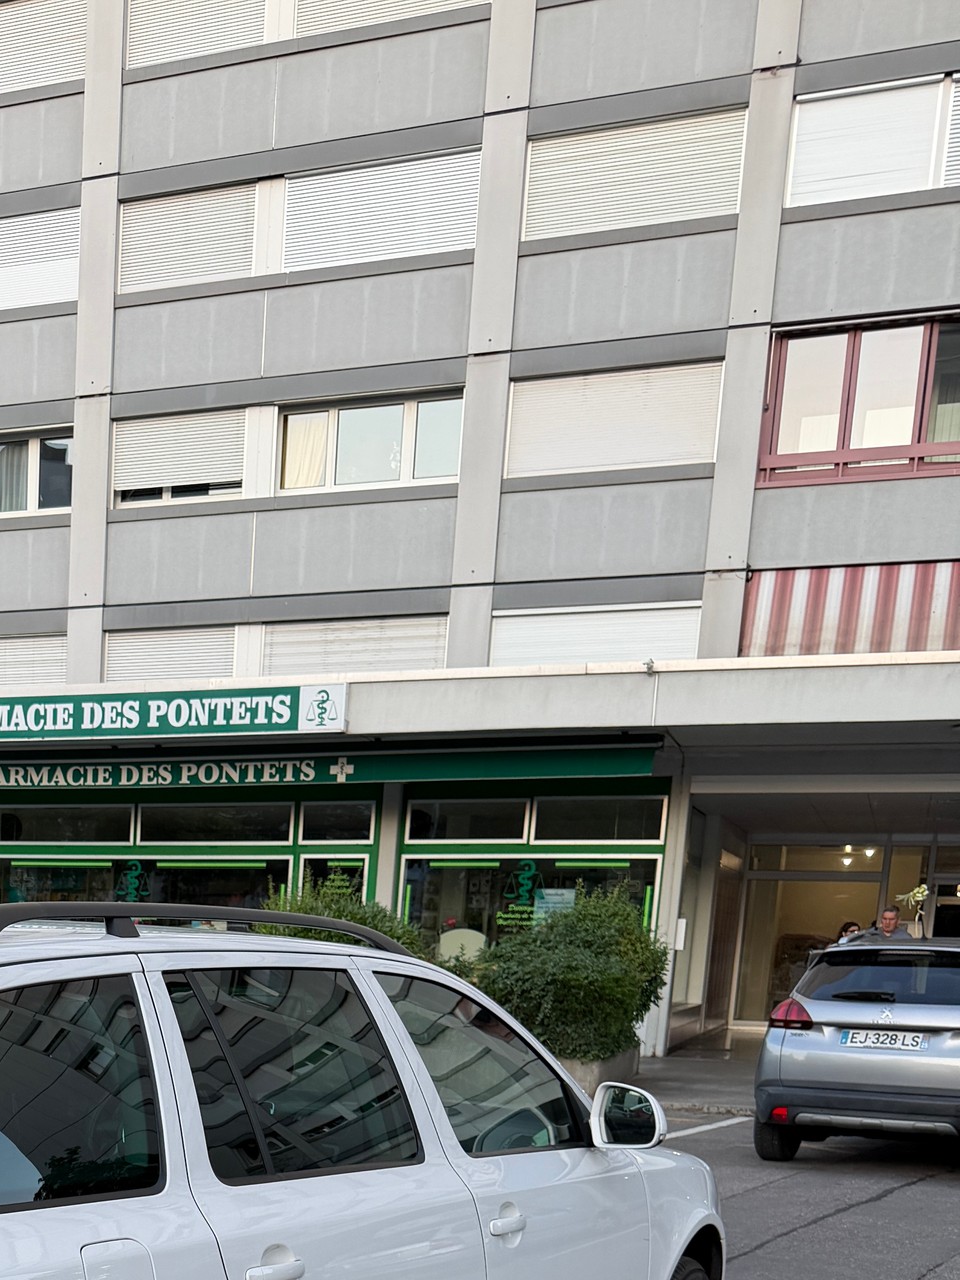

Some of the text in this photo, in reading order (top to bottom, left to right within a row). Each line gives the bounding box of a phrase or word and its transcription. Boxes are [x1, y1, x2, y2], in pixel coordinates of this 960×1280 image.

[81, 700, 140, 730] DES
[148, 694, 291, 728] PONTETS
[129, 764, 172, 785] DES
[180, 761, 316, 784] PONTETS
